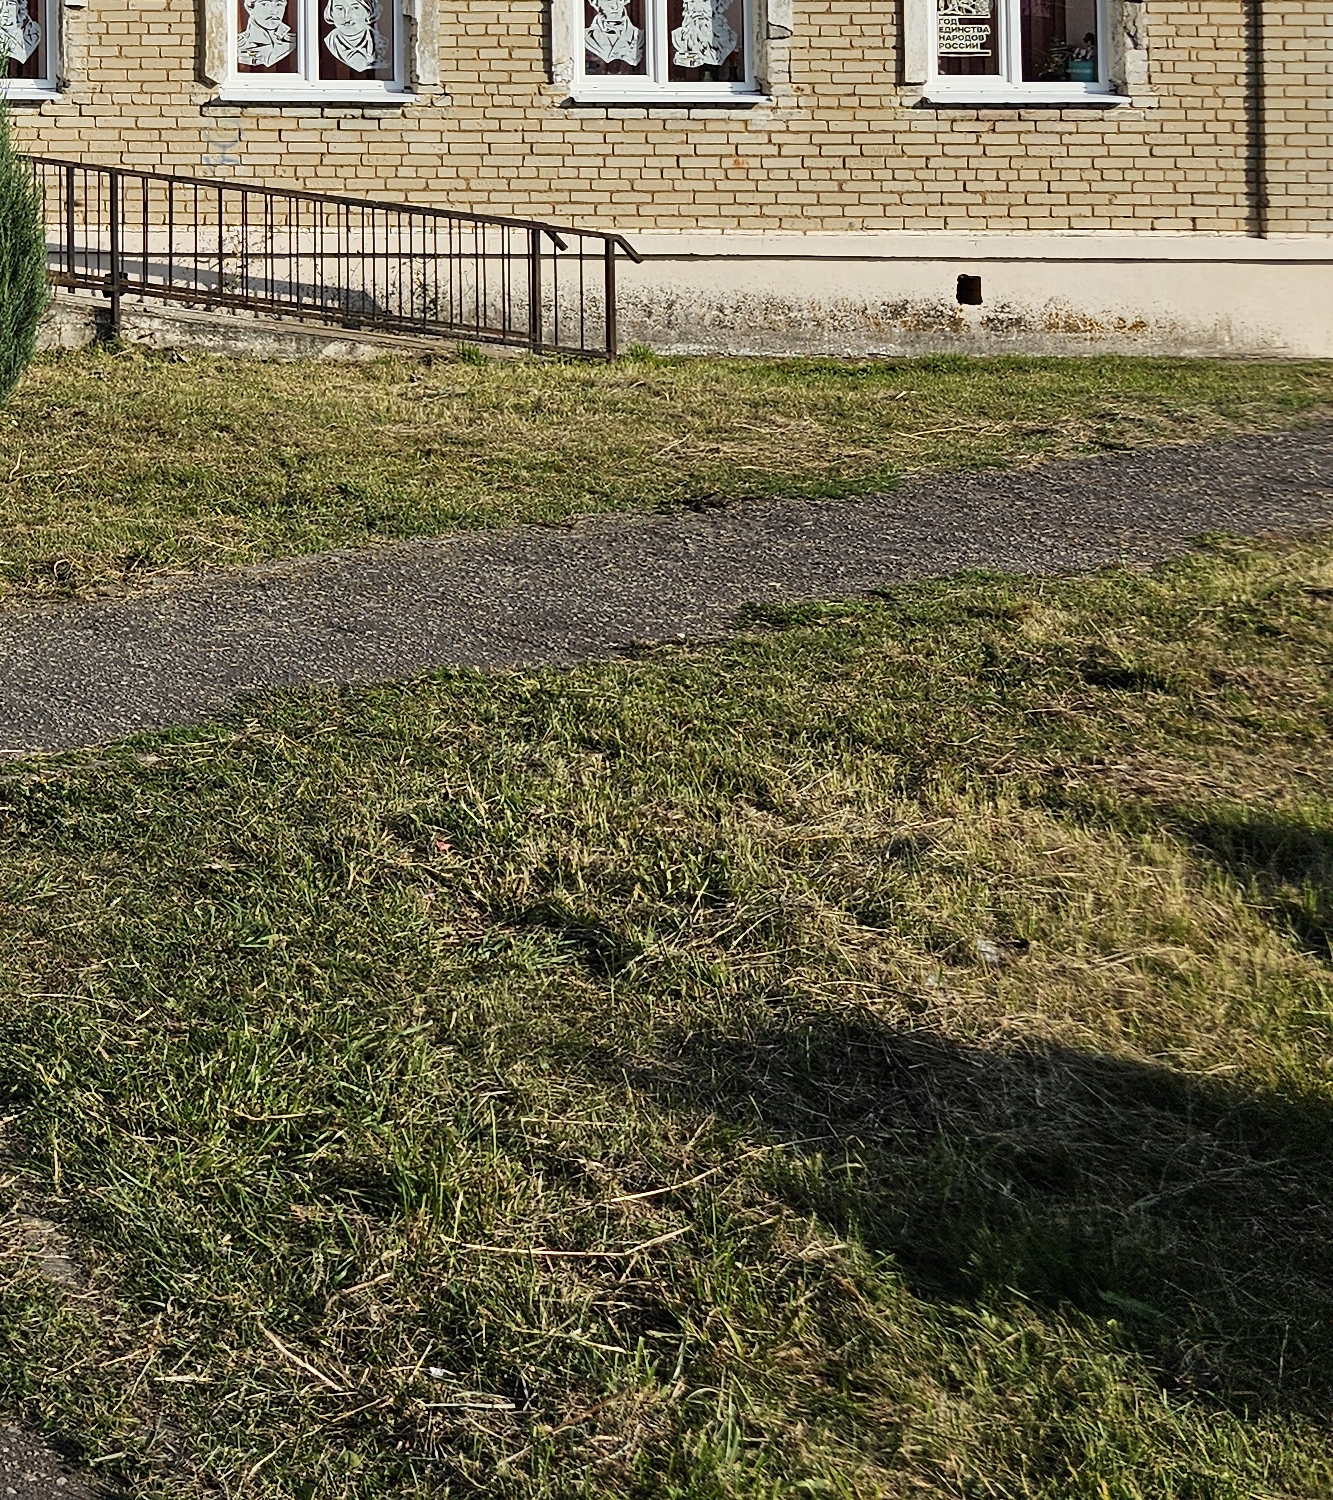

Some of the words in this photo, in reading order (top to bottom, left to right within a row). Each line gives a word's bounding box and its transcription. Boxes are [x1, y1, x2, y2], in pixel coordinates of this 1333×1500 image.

[939, 18, 958, 26] ГОД
[939, 26, 990, 34] ЕДИНСТВА
[939, 34, 985, 42] НАРОДОВ
[939, 42, 979, 50] РОССИИ
